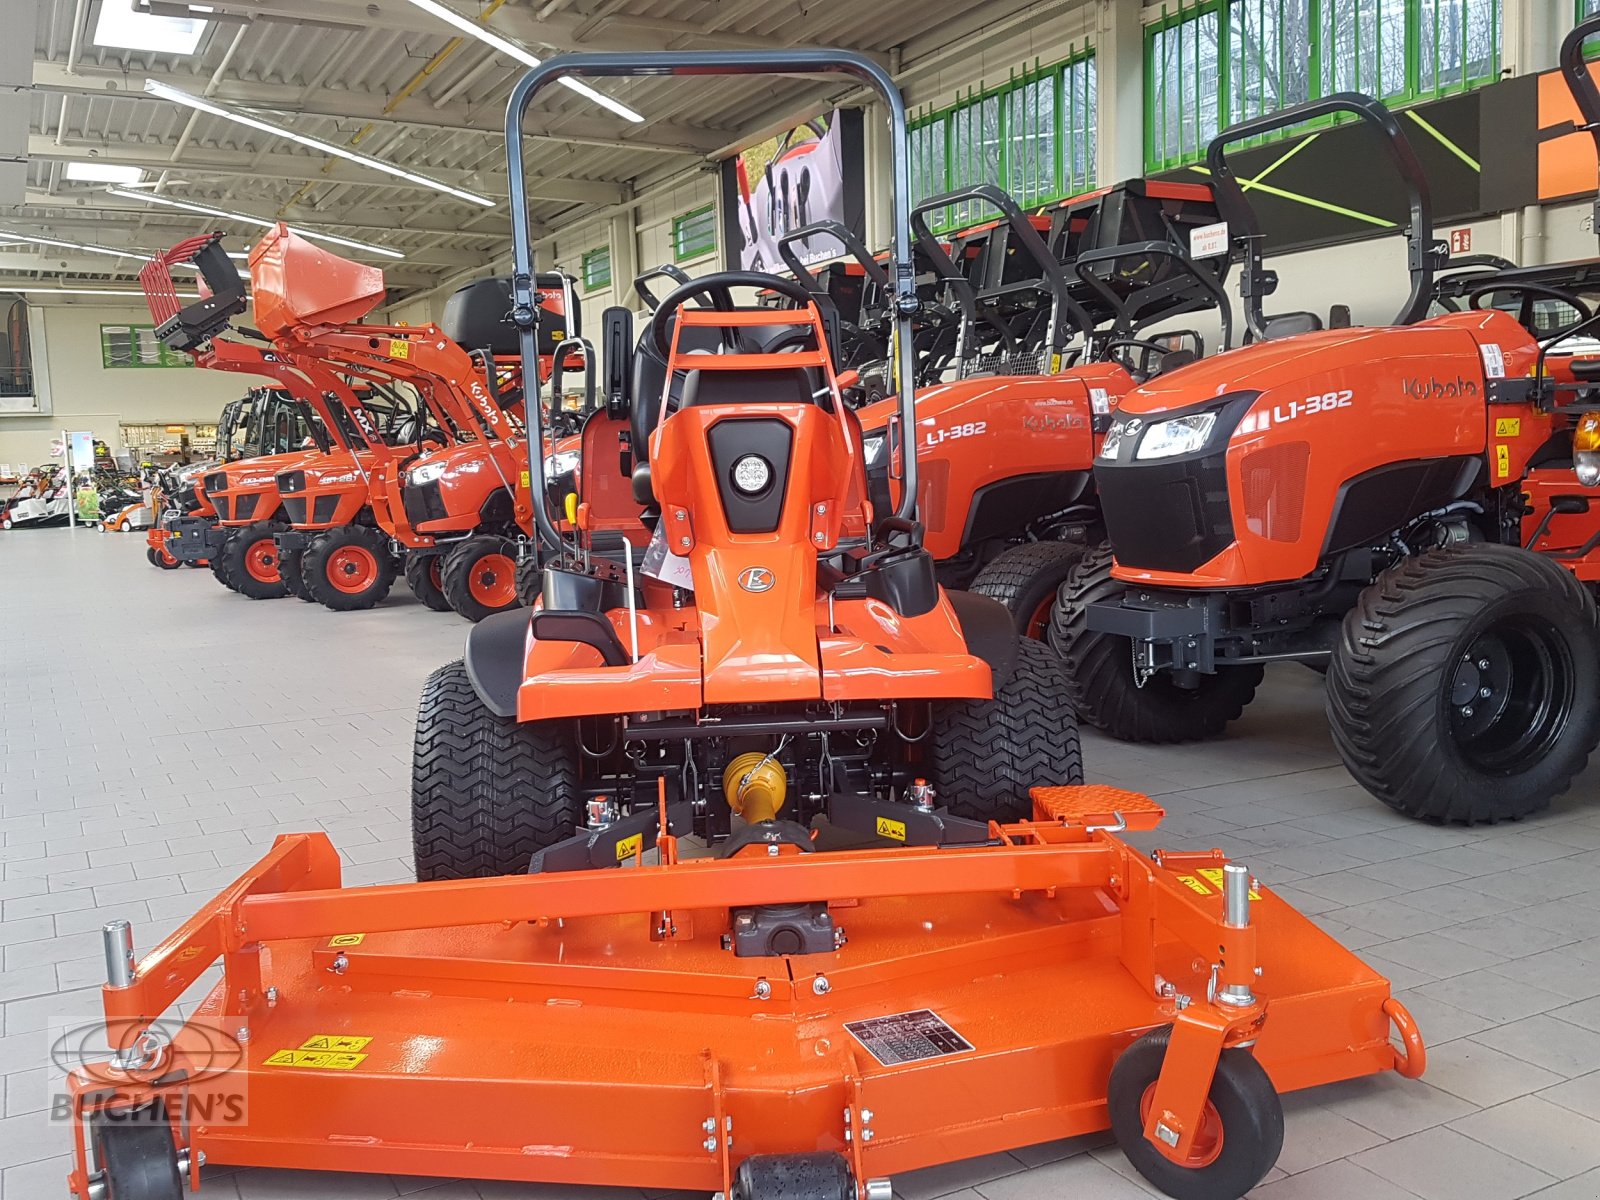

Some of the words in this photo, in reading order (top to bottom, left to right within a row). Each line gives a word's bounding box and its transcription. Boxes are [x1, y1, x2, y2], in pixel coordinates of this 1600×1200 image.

[1402, 375, 1477, 400] Kubota
[470, 381, 499, 425] Kubota
[1274, 389, 1353, 423] L1-382
[353, 408, 374, 434] MX
[926, 421, 987, 445] L1-382
[1023, 413, 1084, 432] Kubota
